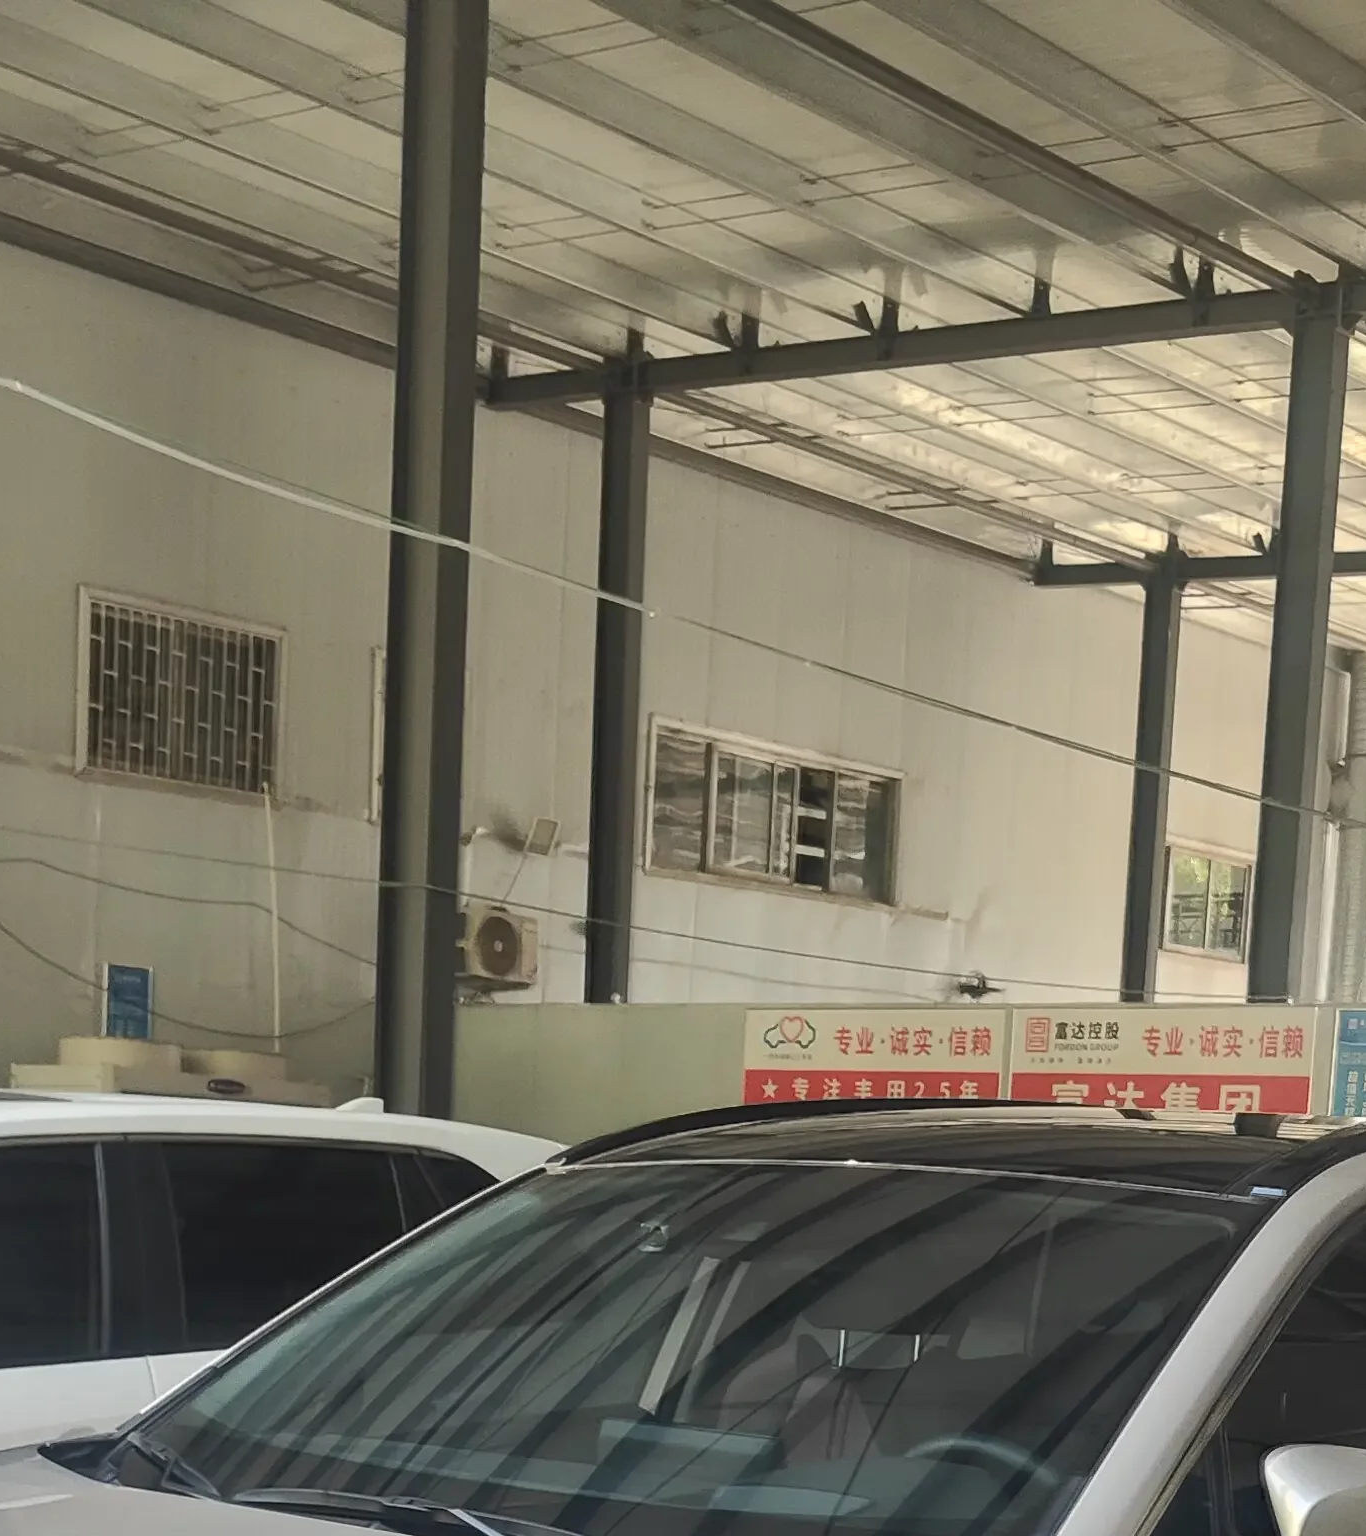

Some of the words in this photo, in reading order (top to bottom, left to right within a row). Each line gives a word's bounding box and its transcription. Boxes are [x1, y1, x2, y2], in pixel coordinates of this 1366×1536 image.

[833, 1024, 992, 1057] 专业·诚实·信赖
[1054, 1021, 1120, 1040] 富达控股
[1142, 1025, 1305, 1058] 专业·诚实·信赖
